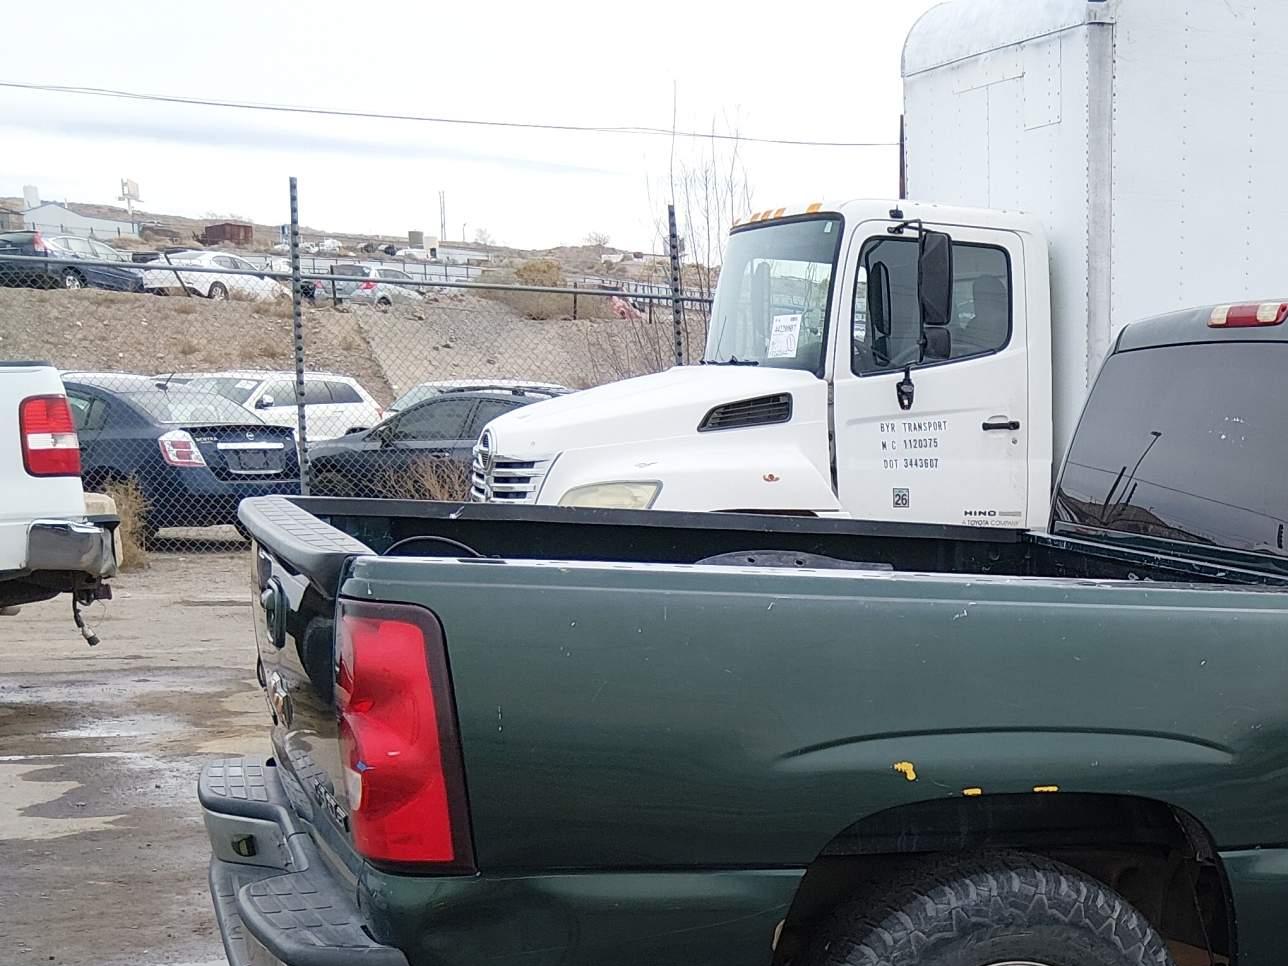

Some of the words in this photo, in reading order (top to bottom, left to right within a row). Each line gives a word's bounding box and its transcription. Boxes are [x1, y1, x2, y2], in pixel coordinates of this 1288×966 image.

[880, 423, 896, 433] BYR
[902, 421, 947, 433] TRANSPORT
[903, 438, 938, 450] 1120375
[883, 459, 899, 469] DOT
[895, 493, 907, 506] 26
